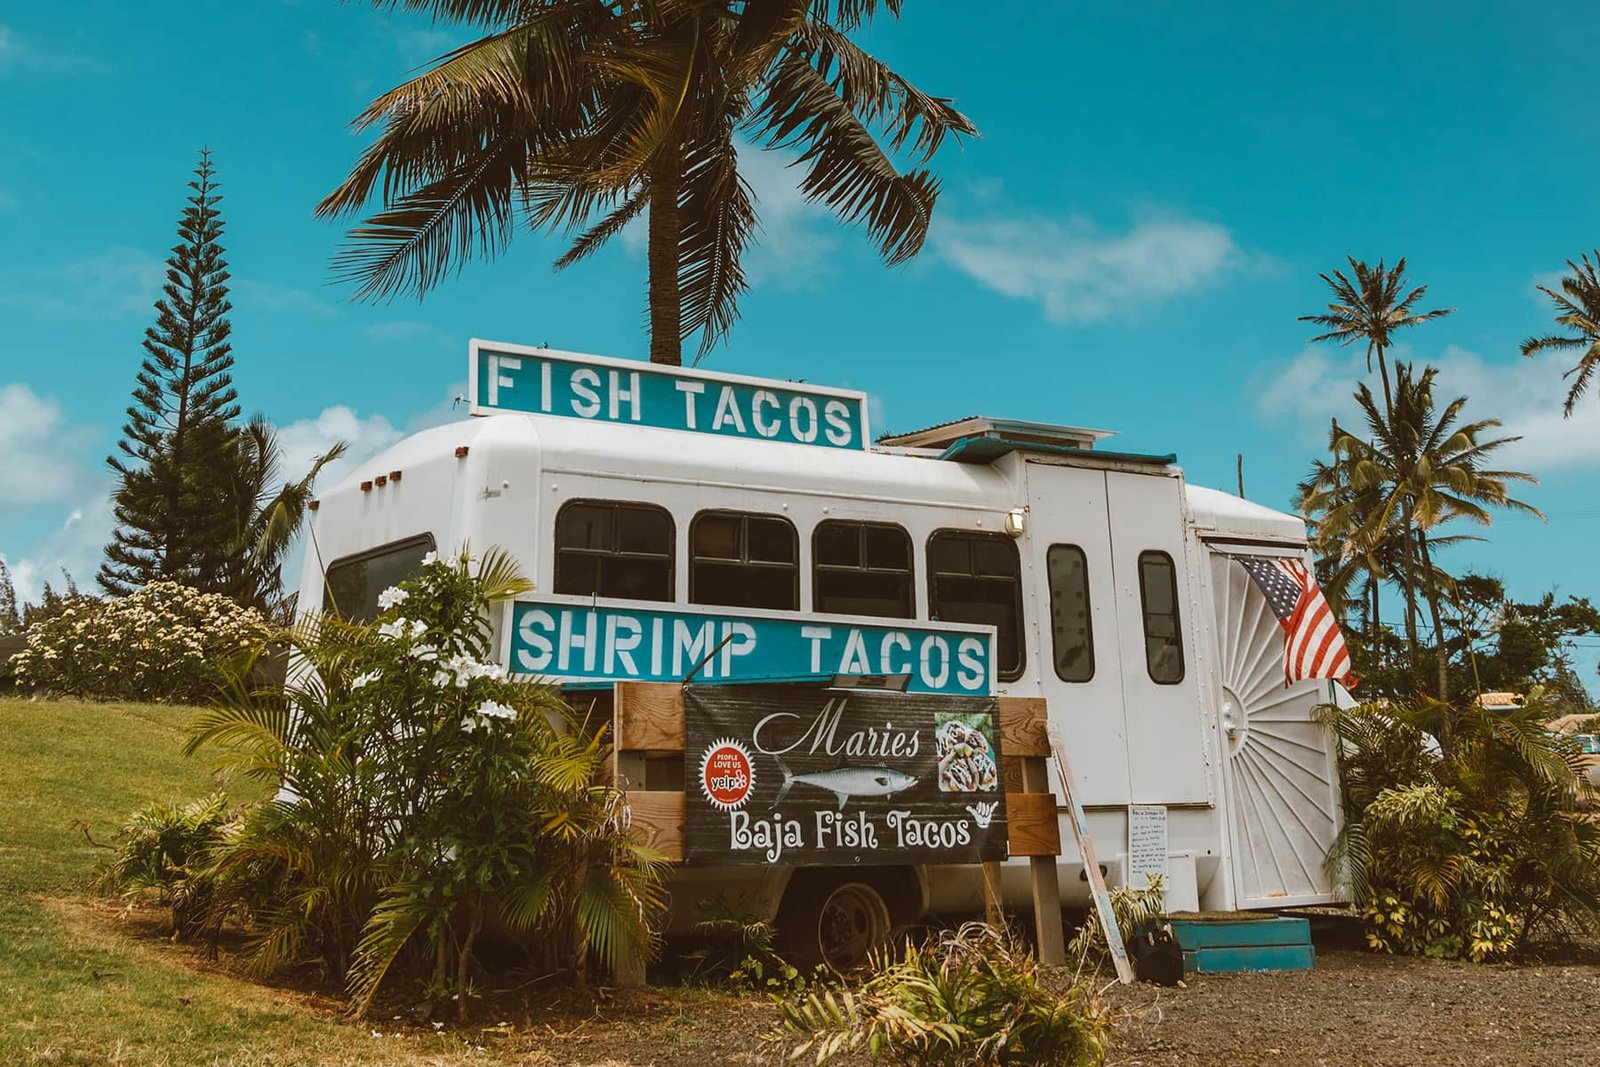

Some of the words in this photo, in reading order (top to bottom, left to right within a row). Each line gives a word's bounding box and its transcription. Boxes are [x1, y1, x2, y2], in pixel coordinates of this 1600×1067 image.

[487, 354, 641, 421] FISH
[675, 380, 852, 446] TACOS
[517, 610, 757, 677] SHRIMP
[801, 627, 985, 690] TACOS
[753, 698, 920, 756] Maries
[711, 775, 736, 791] yelp
[713, 761, 731, 769] LOVE
[732, 761, 742, 769] US
[730, 810, 804, 863] Baja
[815, 809, 879, 850] Fish
[886, 809, 971, 849] Tacos
